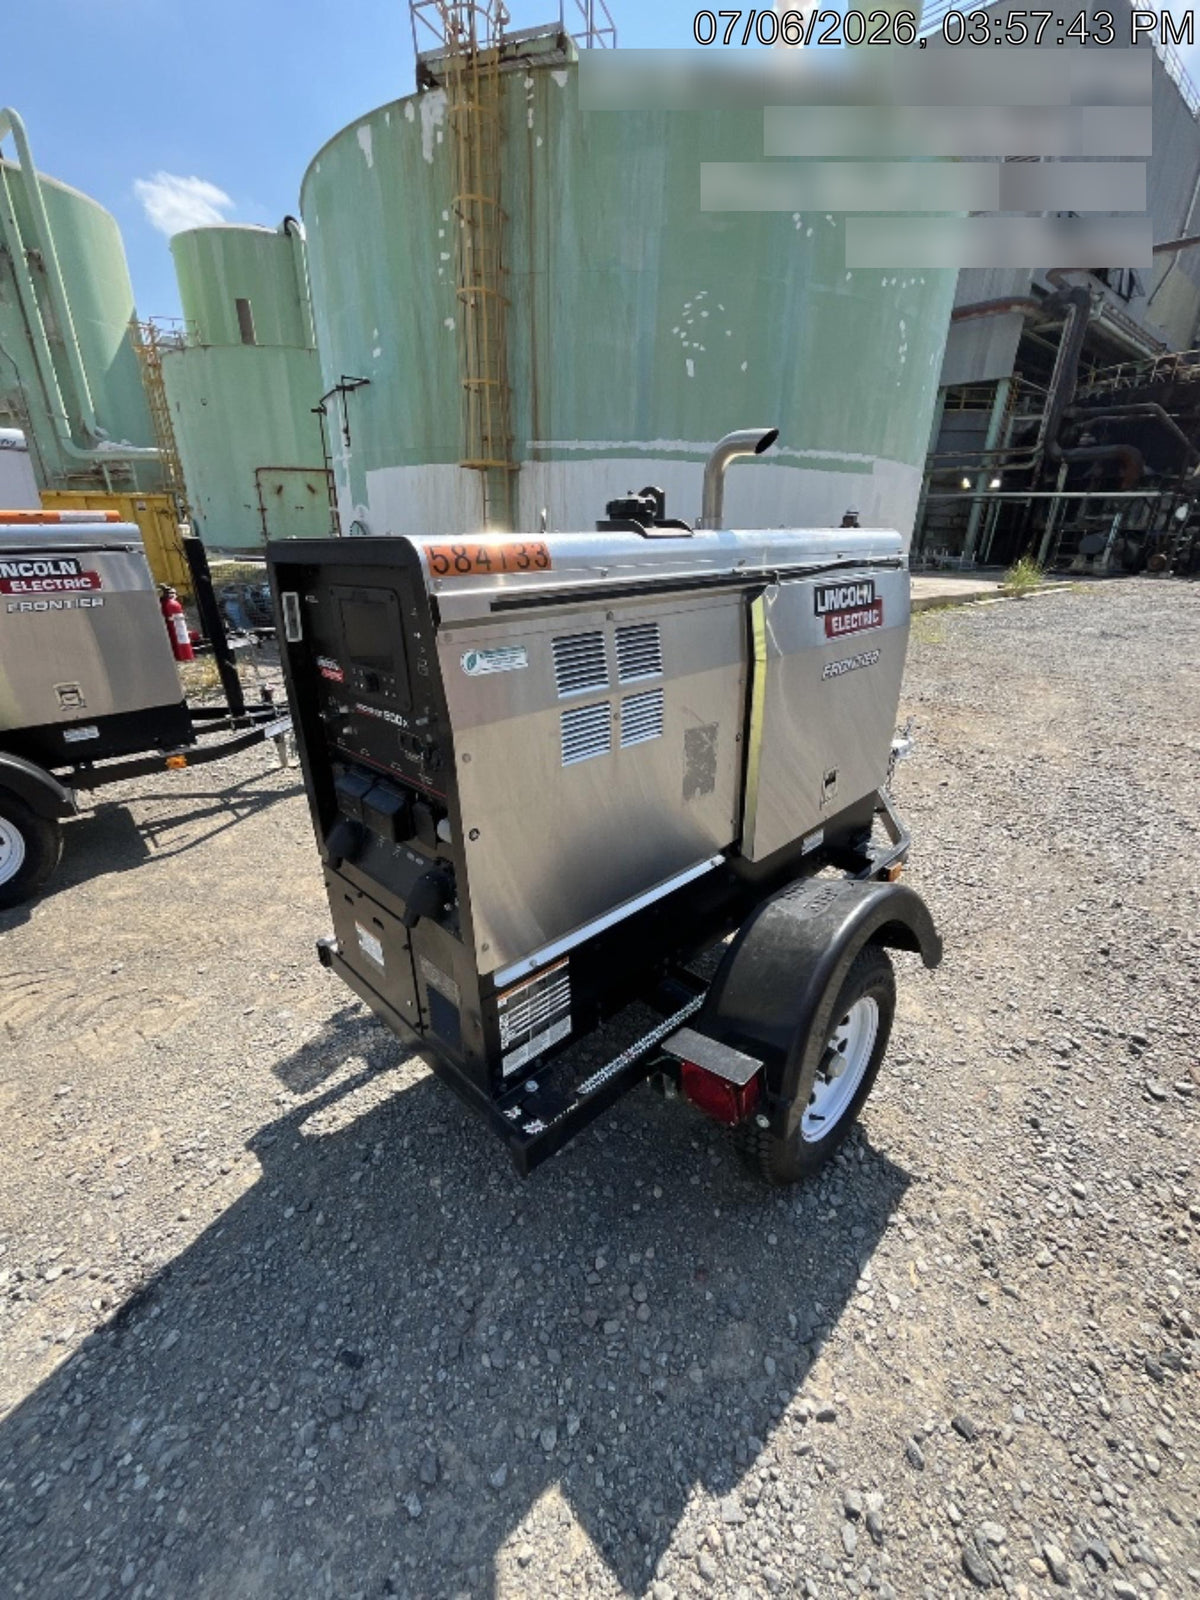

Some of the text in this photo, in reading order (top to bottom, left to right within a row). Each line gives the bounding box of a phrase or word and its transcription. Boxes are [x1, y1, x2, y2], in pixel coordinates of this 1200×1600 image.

[10, 577, 92, 592] ELECTRIC
[817, 583, 872, 612] LINCOLN
[831, 609, 879, 633] ELECTRIC
